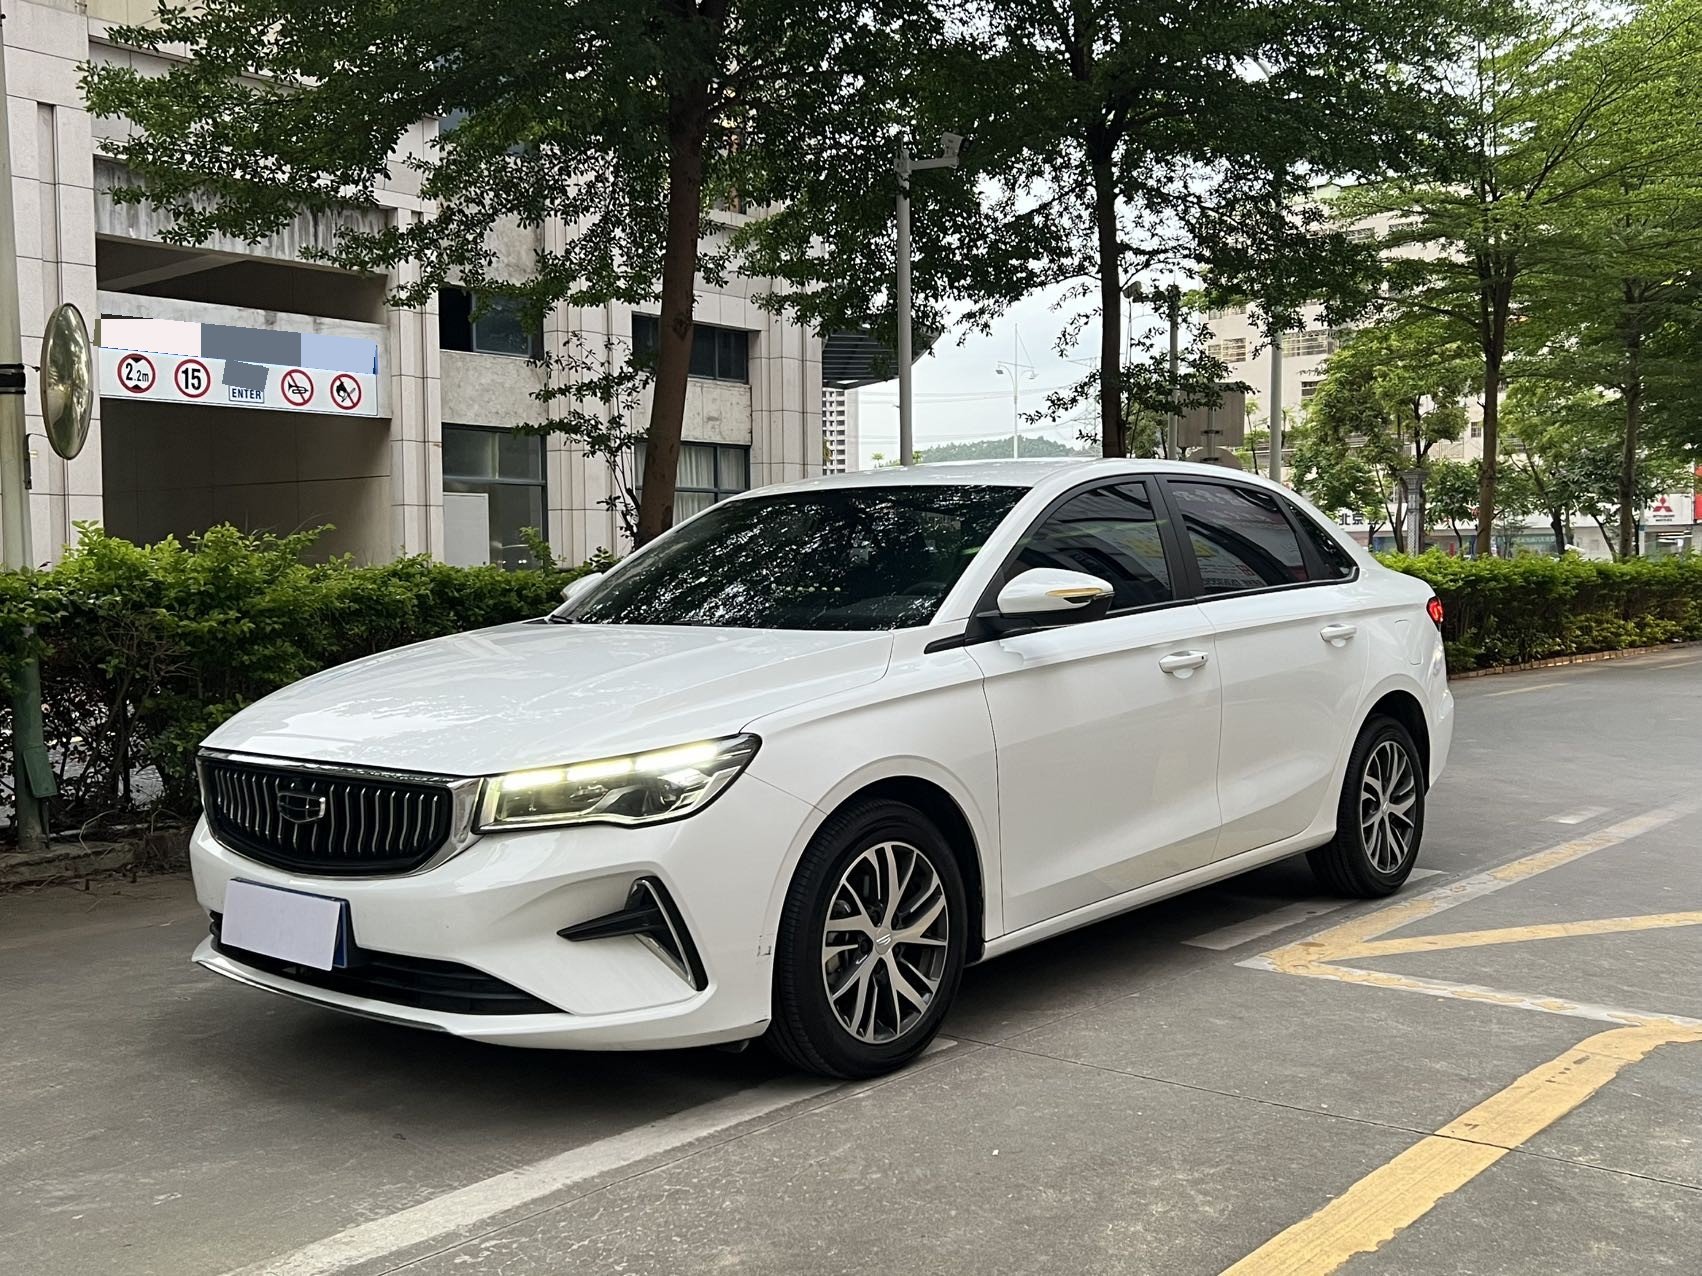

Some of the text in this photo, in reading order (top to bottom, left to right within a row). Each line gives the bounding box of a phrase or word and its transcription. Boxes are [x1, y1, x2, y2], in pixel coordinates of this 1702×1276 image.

[125, 362, 149, 382] 2.2m
[181, 367, 202, 390] 15
[231, 388, 262, 400] ENTER
